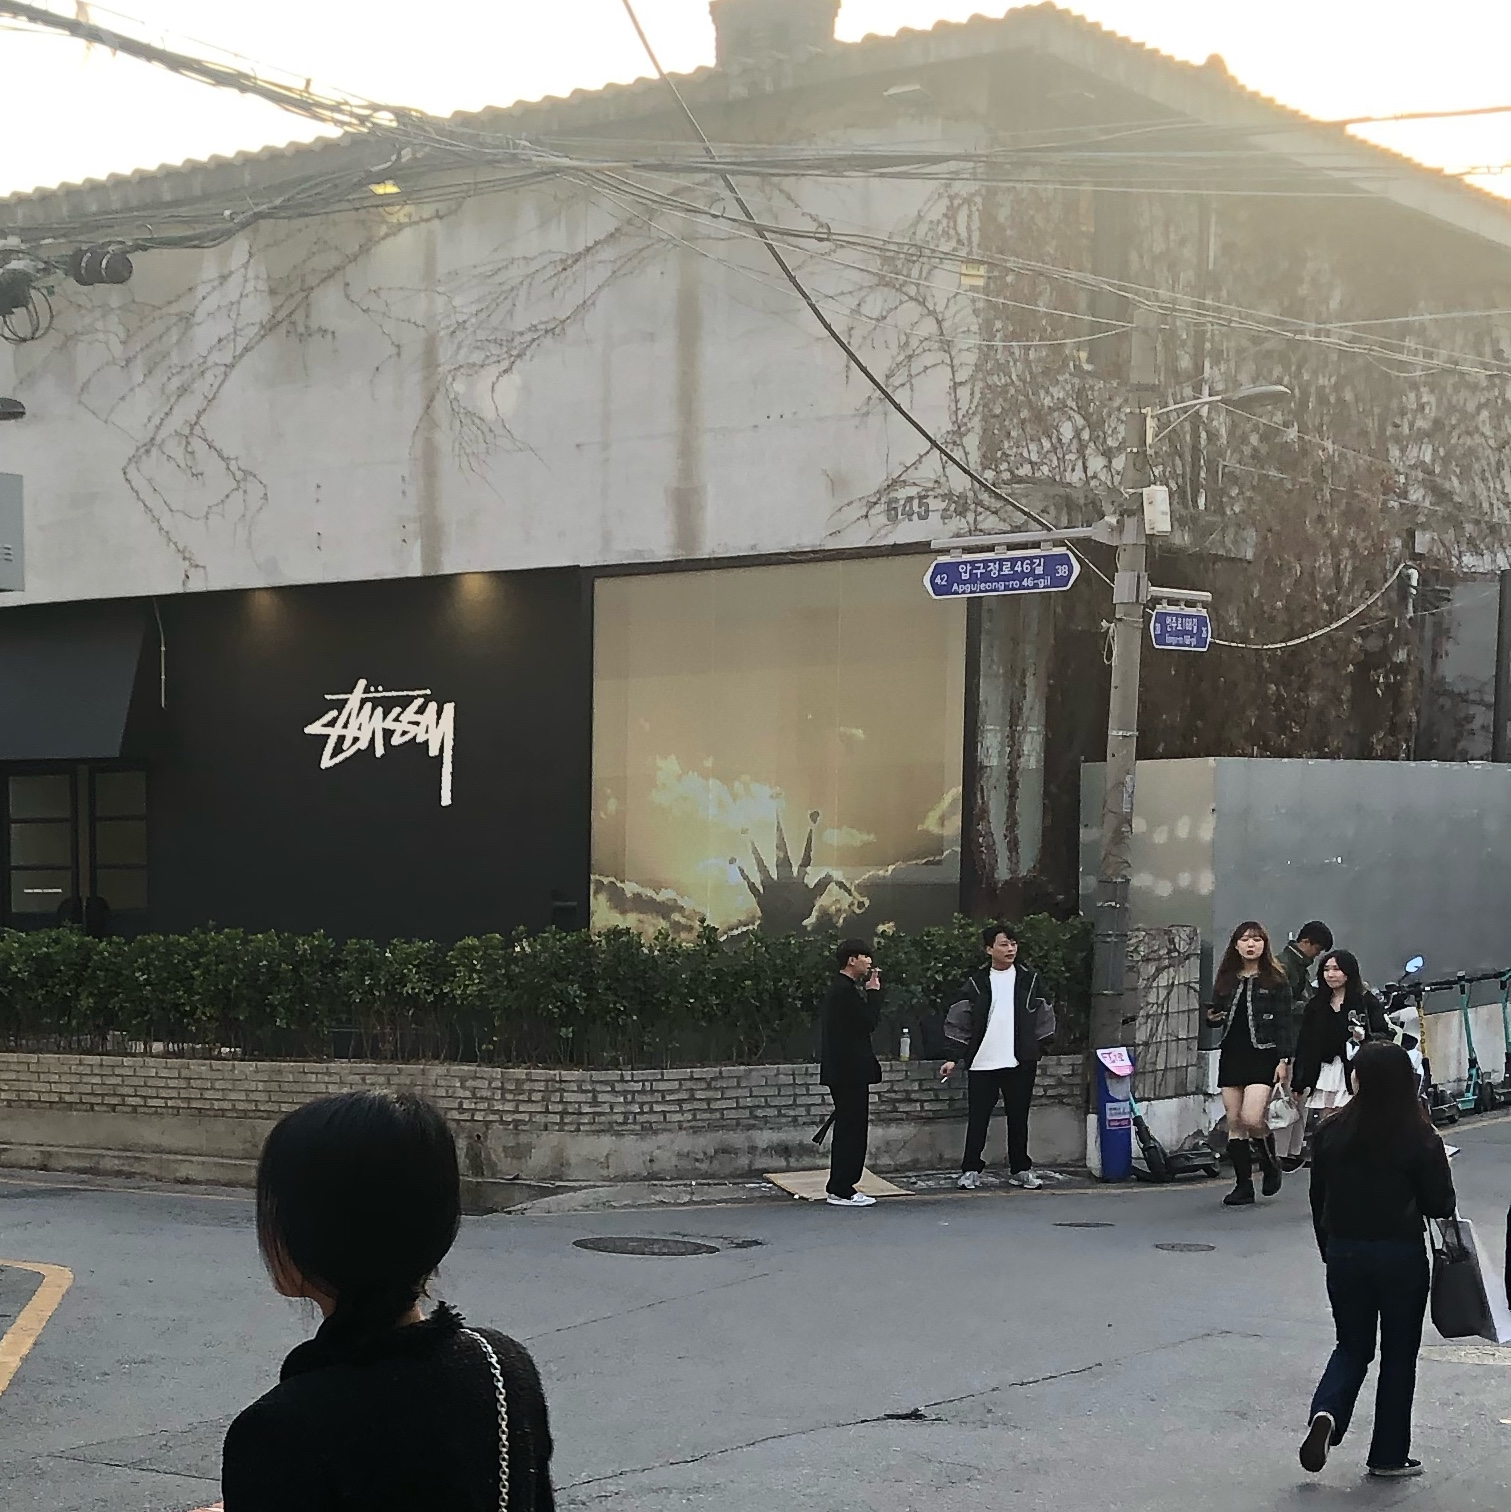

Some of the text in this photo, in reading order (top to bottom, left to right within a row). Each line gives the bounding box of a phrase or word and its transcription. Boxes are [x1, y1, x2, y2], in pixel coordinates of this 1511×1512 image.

[958, 557, 1045, 580] 압구정로46길
[1055, 565, 1069, 577] 38
[934, 574, 948, 586] 42
[951, 576, 1051, 594] Apgujeong-ro 46-gil
